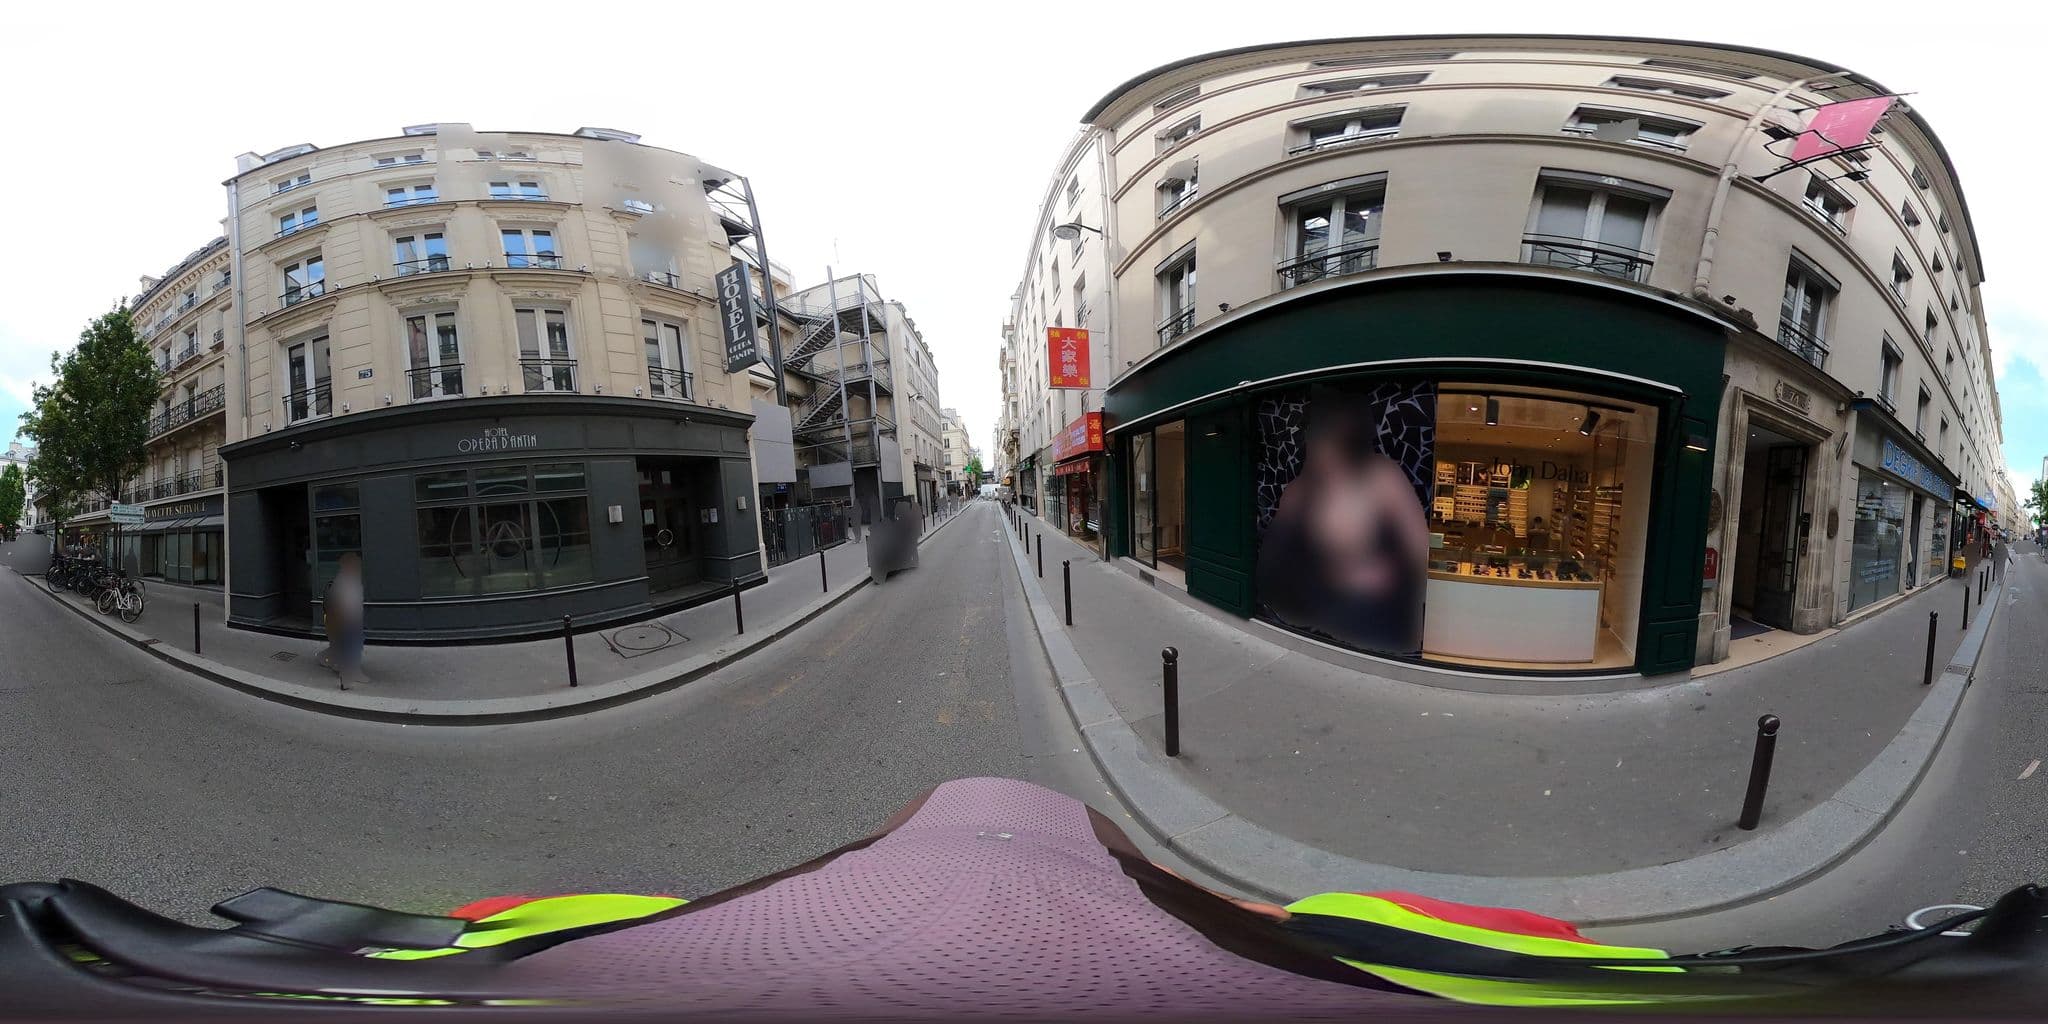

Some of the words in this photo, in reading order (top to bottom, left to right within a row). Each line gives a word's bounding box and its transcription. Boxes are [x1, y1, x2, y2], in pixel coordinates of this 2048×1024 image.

[720, 268, 747, 343] HOTEL
[501, 434, 537, 449] D'ANTIN
[1490, 456, 1535, 480] John
